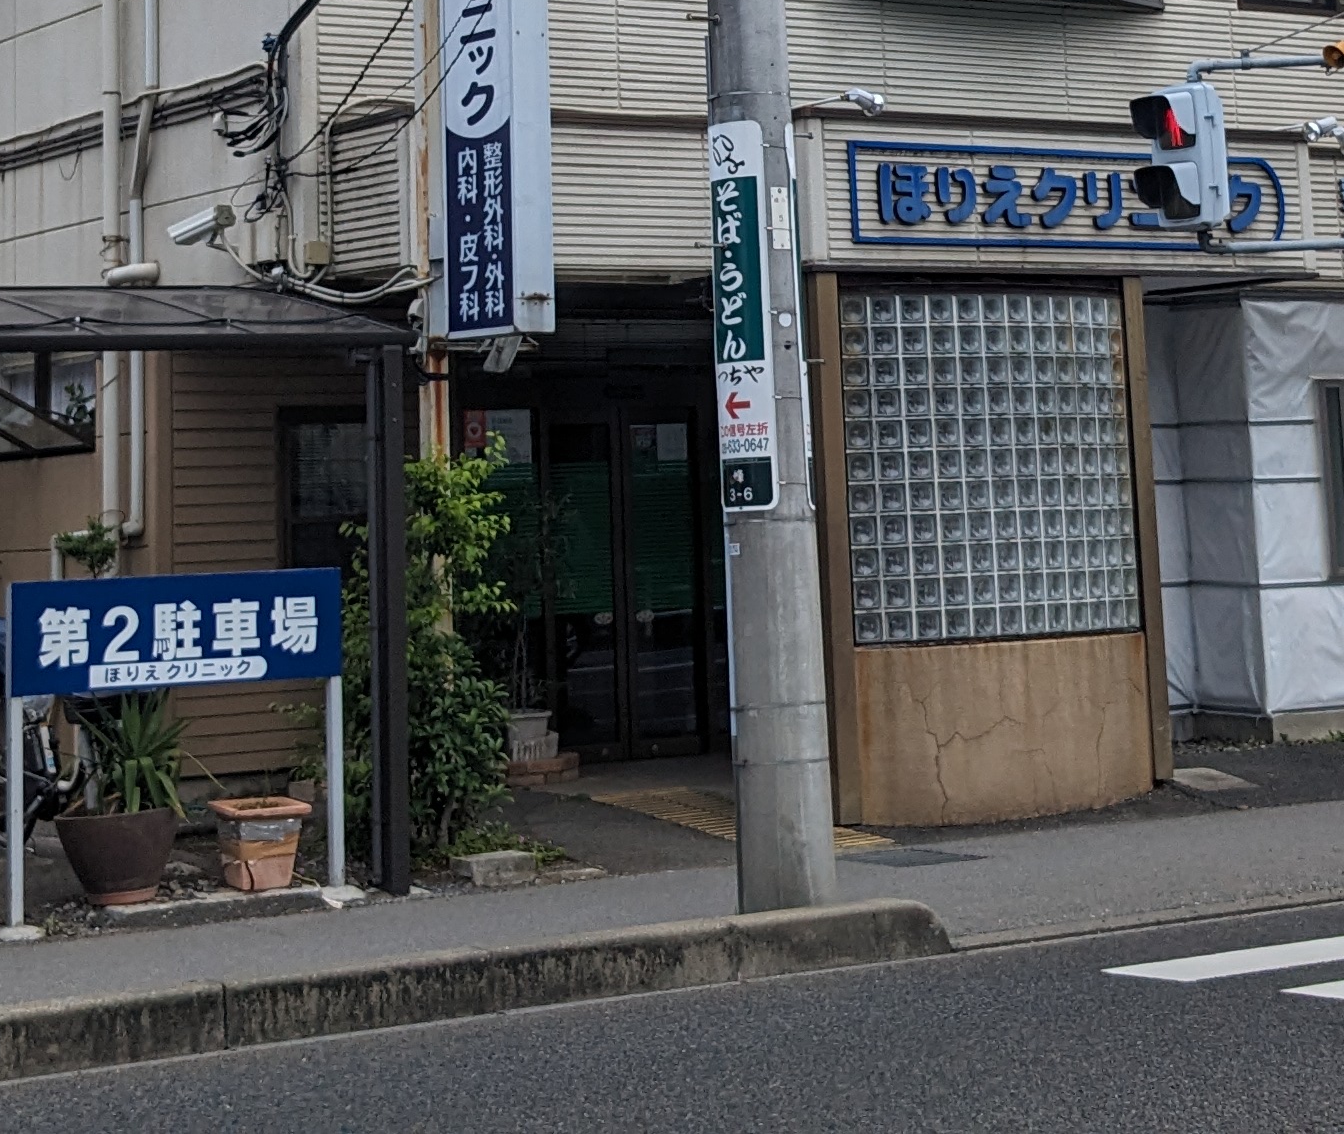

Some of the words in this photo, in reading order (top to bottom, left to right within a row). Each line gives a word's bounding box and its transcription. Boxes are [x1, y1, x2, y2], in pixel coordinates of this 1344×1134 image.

[482, 141, 506, 319] 整形外科・外科
[875, 160, 1262, 234] ほりえクリク
[457, 146, 481, 323] 内科・皮フ科
[716, 180, 748, 361] そば・うどん
[729, 487, 754, 502] 3-6
[38, 595, 319, 668] 第2駐車場
[104, 659, 252, 684] ほりえクリニック
